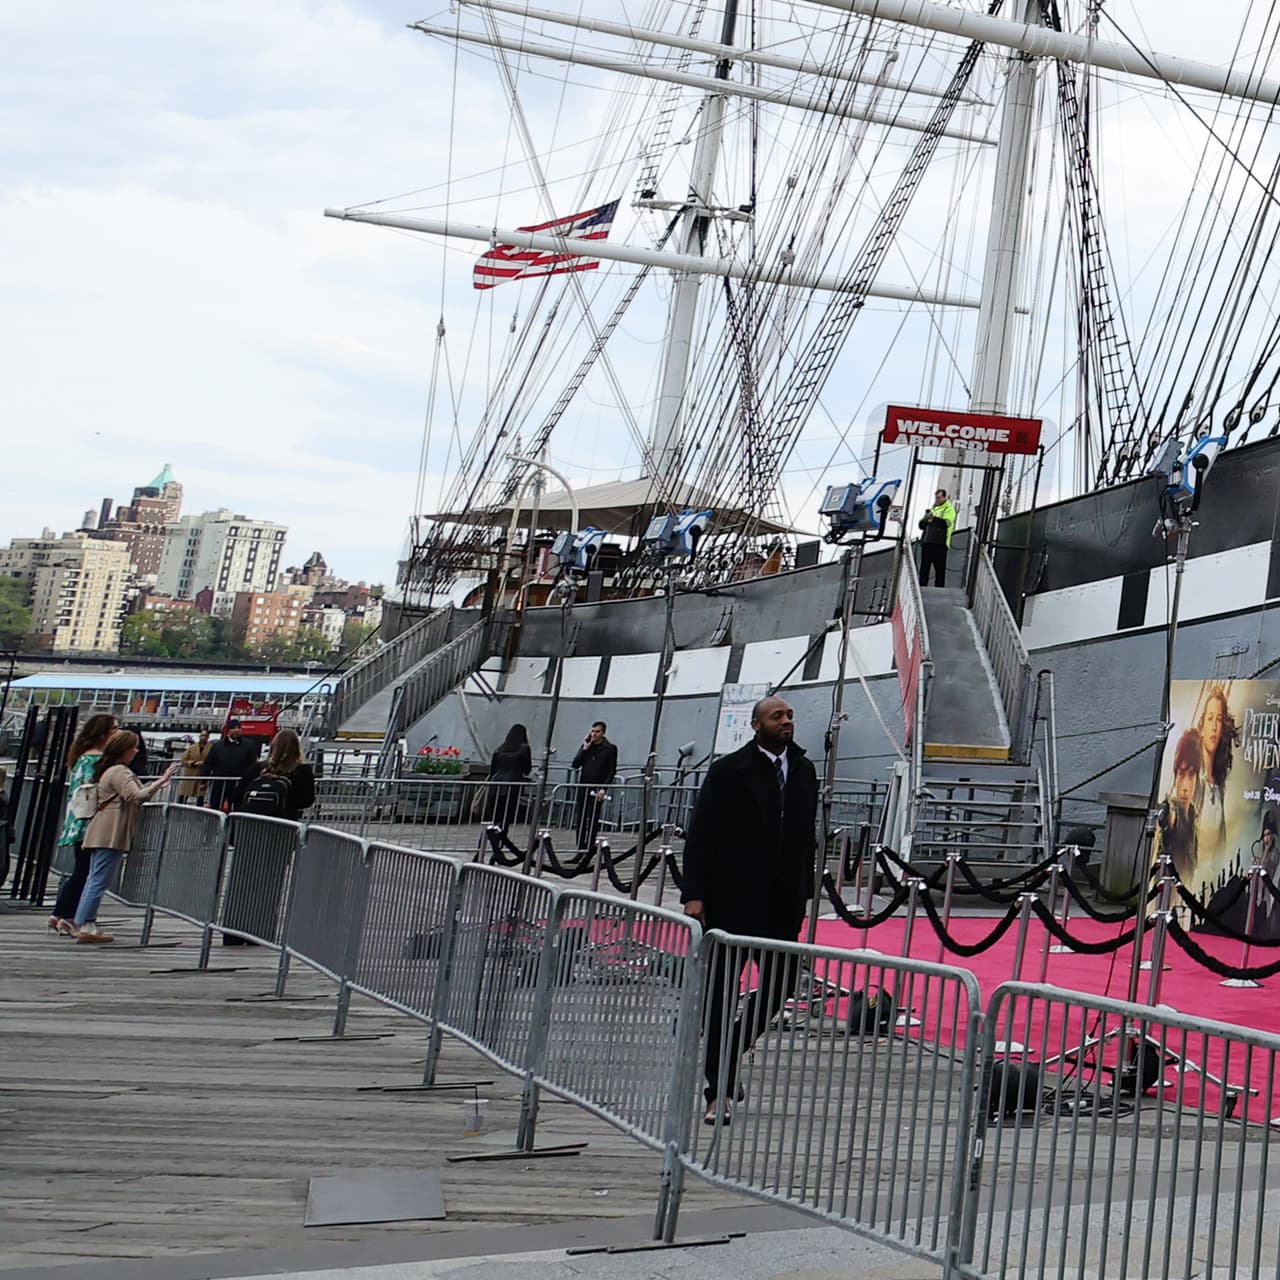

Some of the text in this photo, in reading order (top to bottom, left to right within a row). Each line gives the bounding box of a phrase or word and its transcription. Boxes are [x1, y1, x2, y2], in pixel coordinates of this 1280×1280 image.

[897, 419, 1010, 442] WELCOME
[895, 434, 990, 451] ABOARD!
[1240, 708, 1280, 748] PETER
